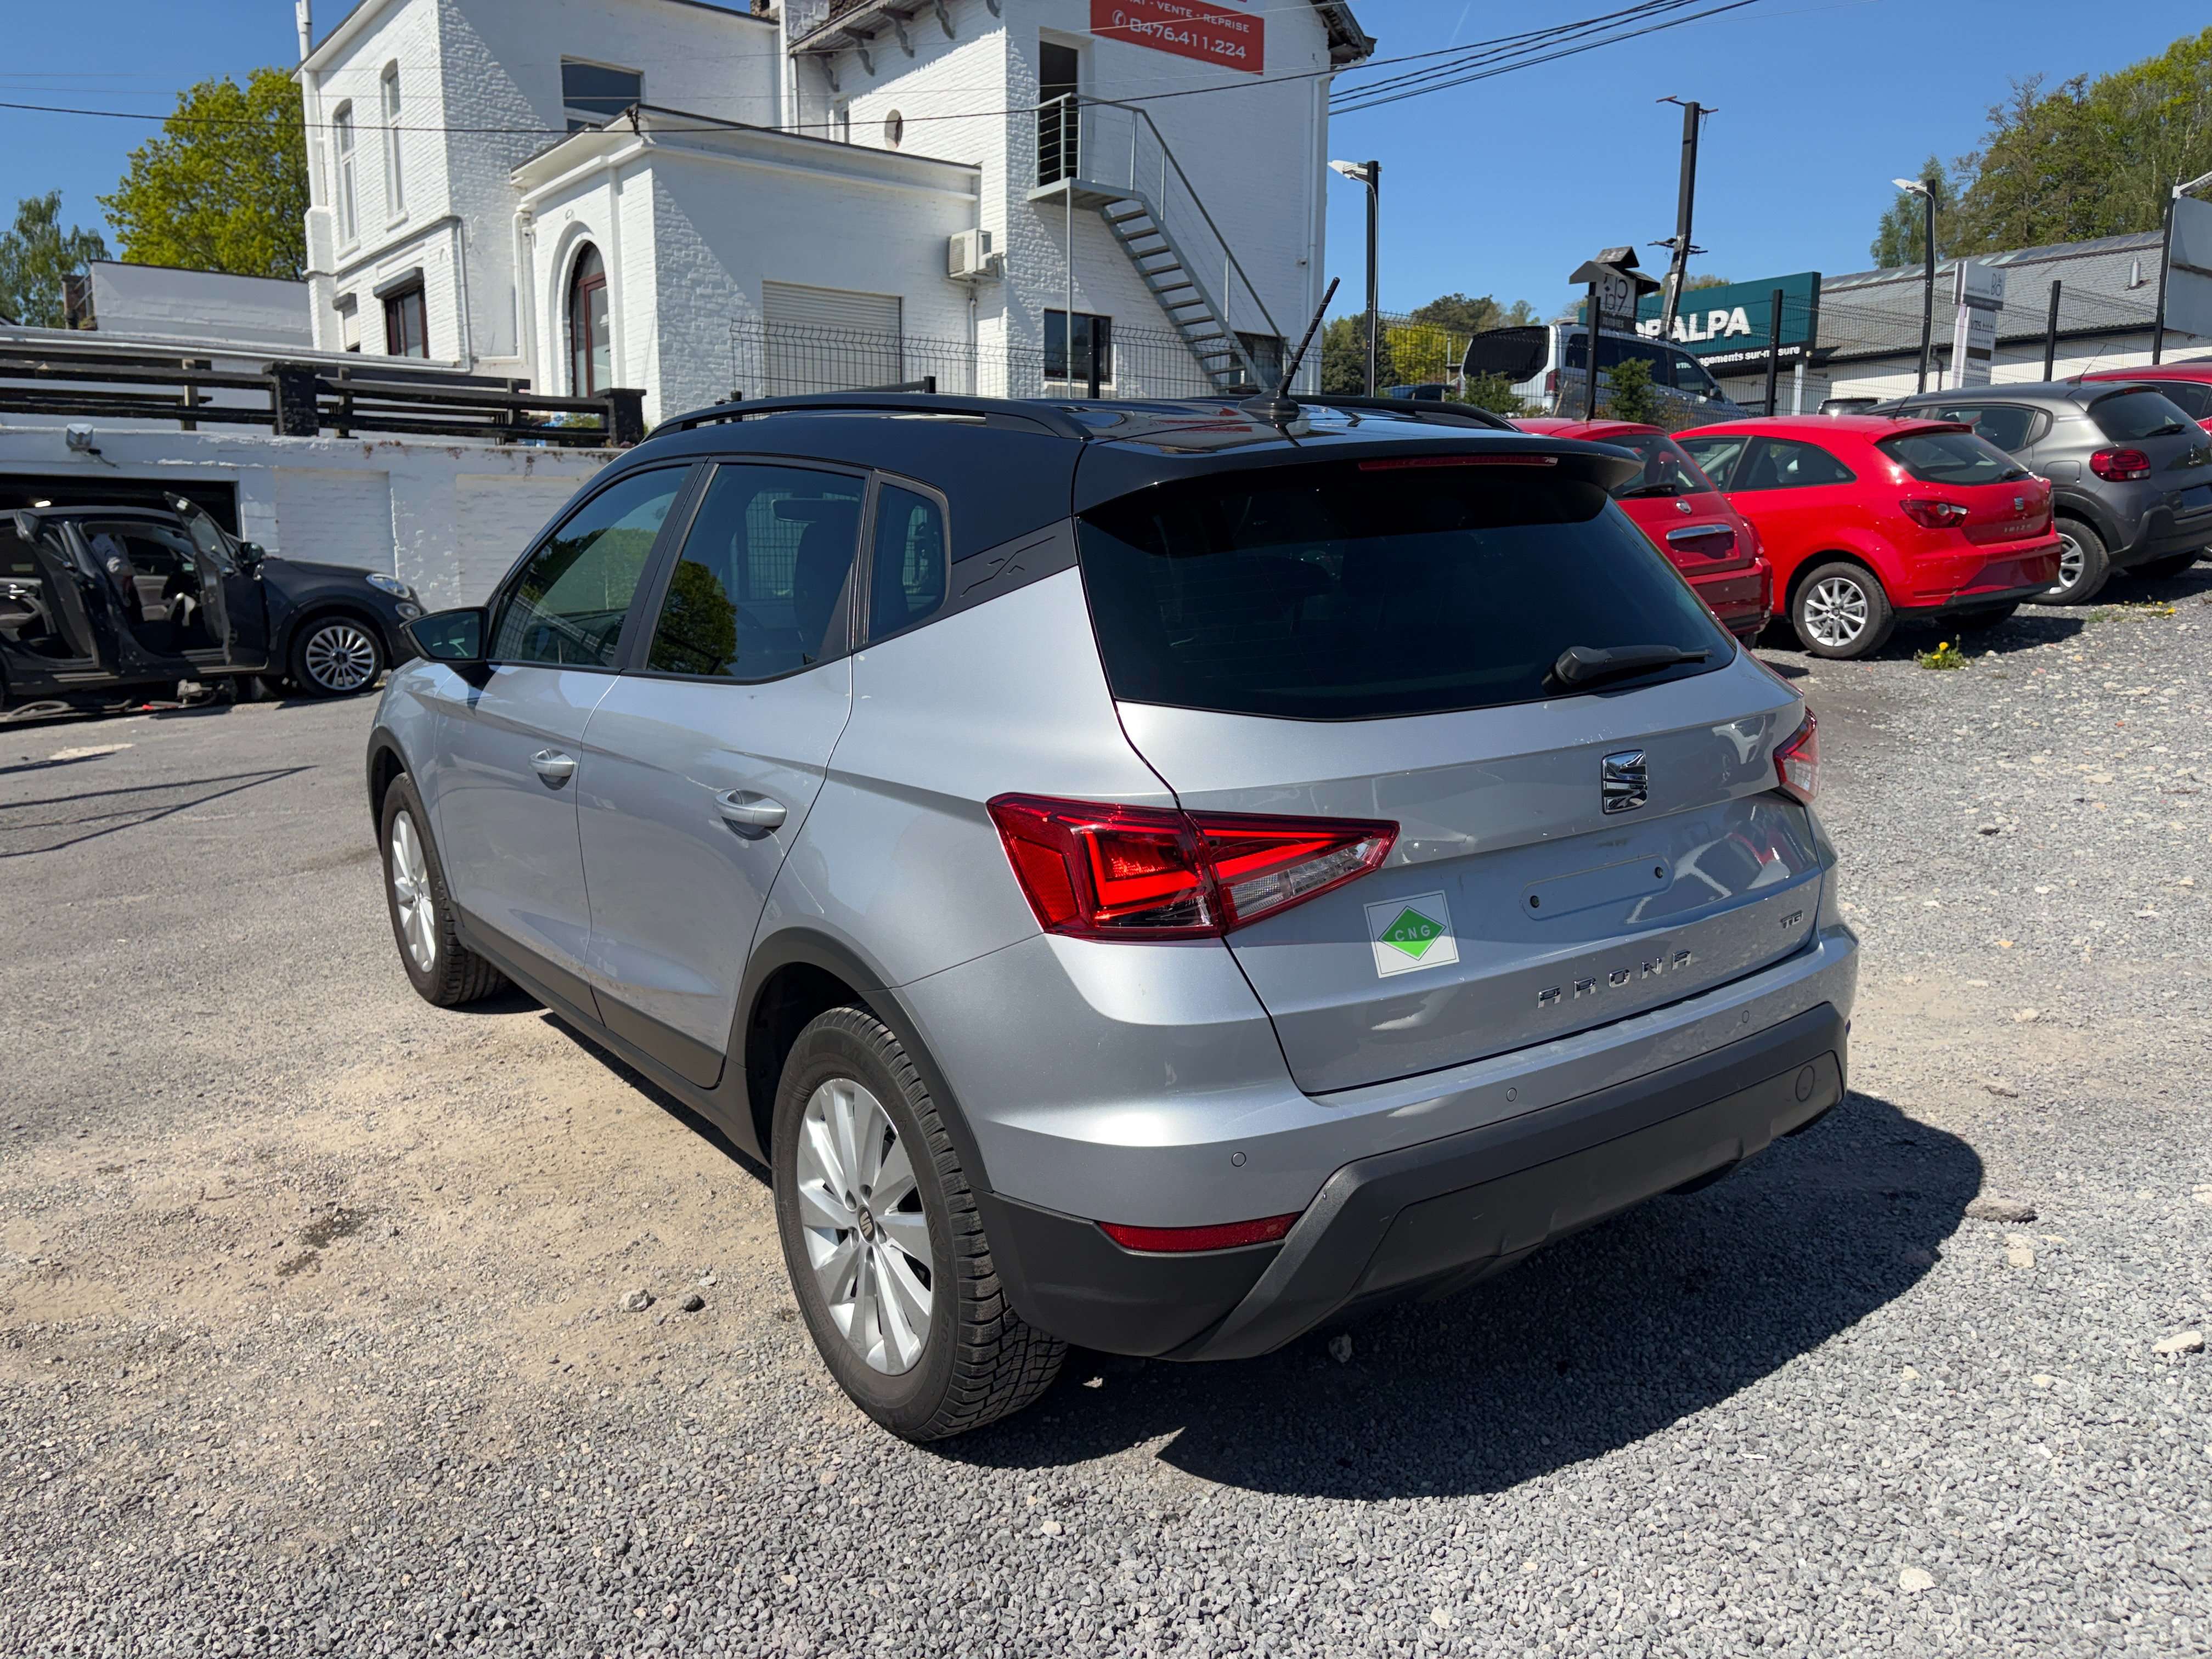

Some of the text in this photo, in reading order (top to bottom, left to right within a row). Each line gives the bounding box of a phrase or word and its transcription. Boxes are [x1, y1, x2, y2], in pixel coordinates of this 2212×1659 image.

[1157, 2, 1193, 18] VENTE
[1203, 14, 1250, 32] REPRISE
[1130, 18, 1246, 58] 0476.411.224
[1745, 346, 1800, 360] sur-msure
[1395, 925, 1431, 941] CNG
[1537, 950, 1692, 1009] ARONA
